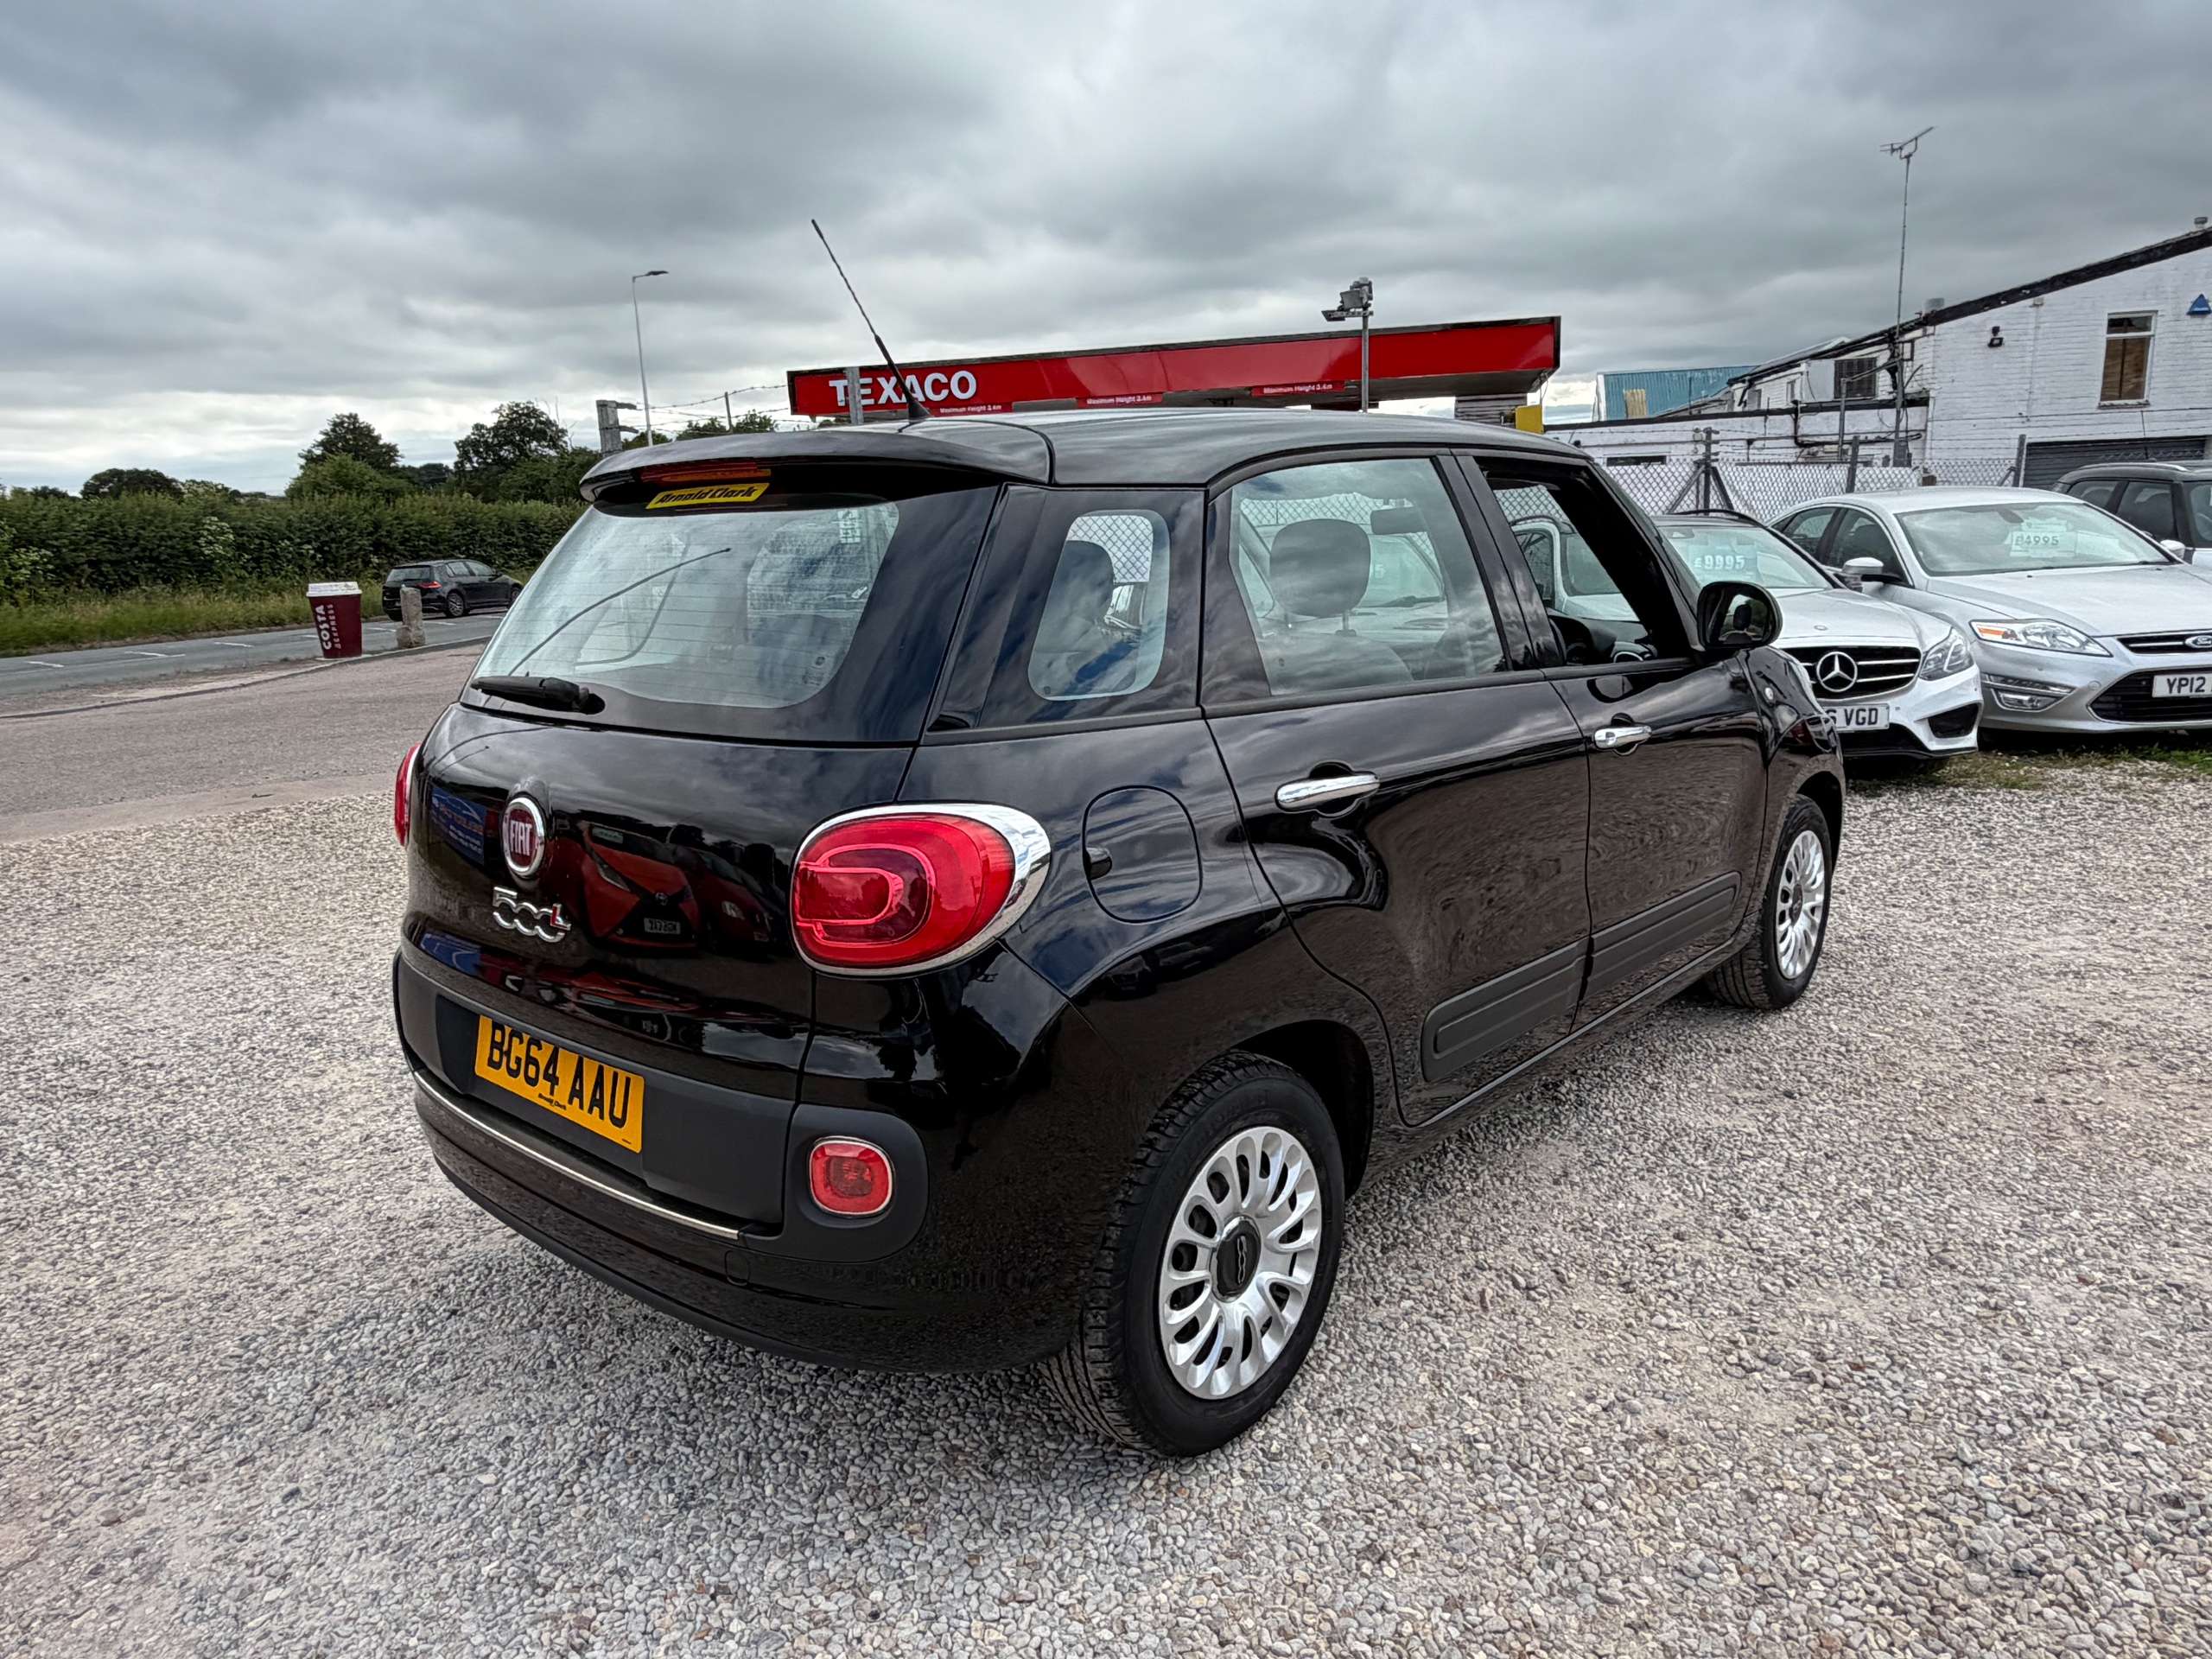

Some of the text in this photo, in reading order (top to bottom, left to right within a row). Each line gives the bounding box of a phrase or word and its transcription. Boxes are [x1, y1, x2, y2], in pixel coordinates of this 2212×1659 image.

[829, 371, 977, 407] TEXACO
[654, 488, 712, 505] Arnold
[2014, 535, 2059, 546] £4995
[315, 605, 333, 650] COSTA
[2166, 676, 2206, 694] YP12
[1843, 707, 1878, 727] VGD
[510, 819, 532, 856] FIAT
[493, 886, 572, 944] 500L
[487, 1020, 632, 1128] BG64 AAU
